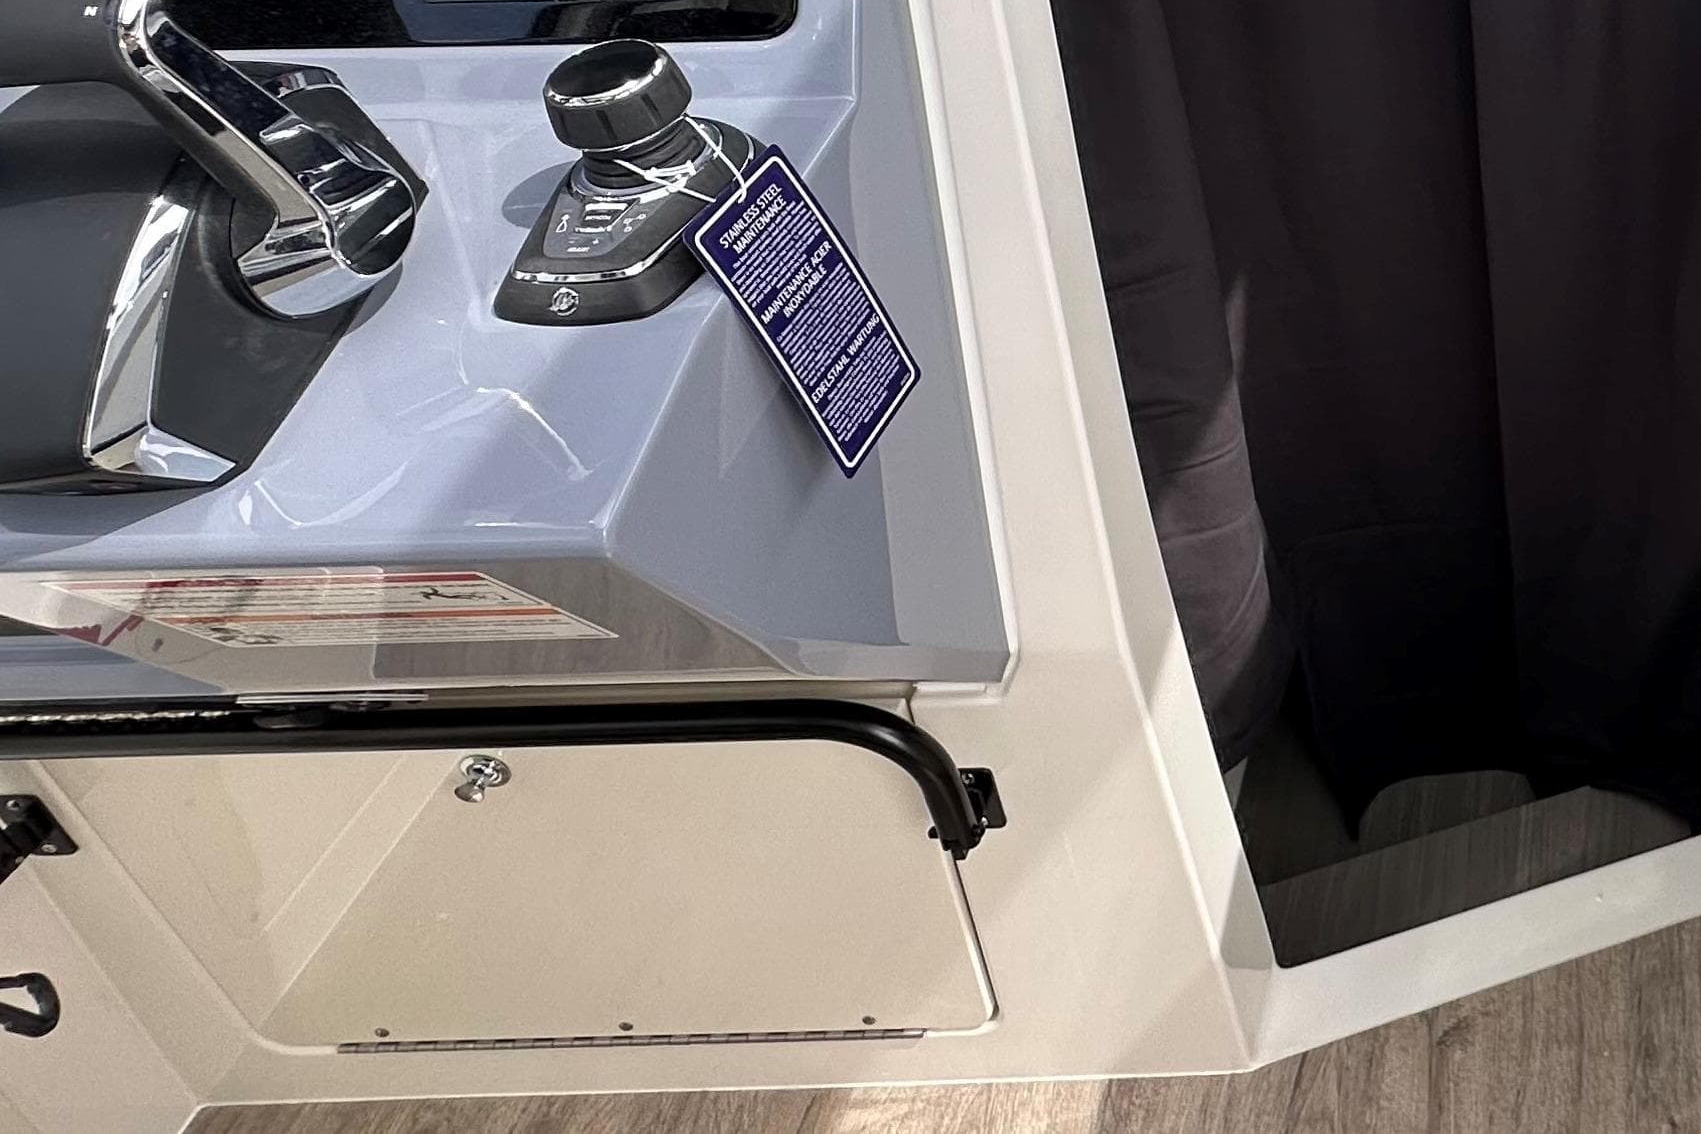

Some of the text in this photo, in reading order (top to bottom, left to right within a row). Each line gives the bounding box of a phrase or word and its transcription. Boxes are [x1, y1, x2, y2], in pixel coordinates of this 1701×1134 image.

[718, 203, 760, 249] STAINLESS
[756, 182, 782, 209] STEEL
[733, 194, 787, 254] MAINTENANCE
[761, 262, 812, 324] MAINTENANCE
[810, 239, 832, 267] ACIER
[783, 263, 828, 317] INOXYDABLE
[811, 352, 850, 403] EDELSTAHL
[847, 312, 880, 356] WARTUNG
